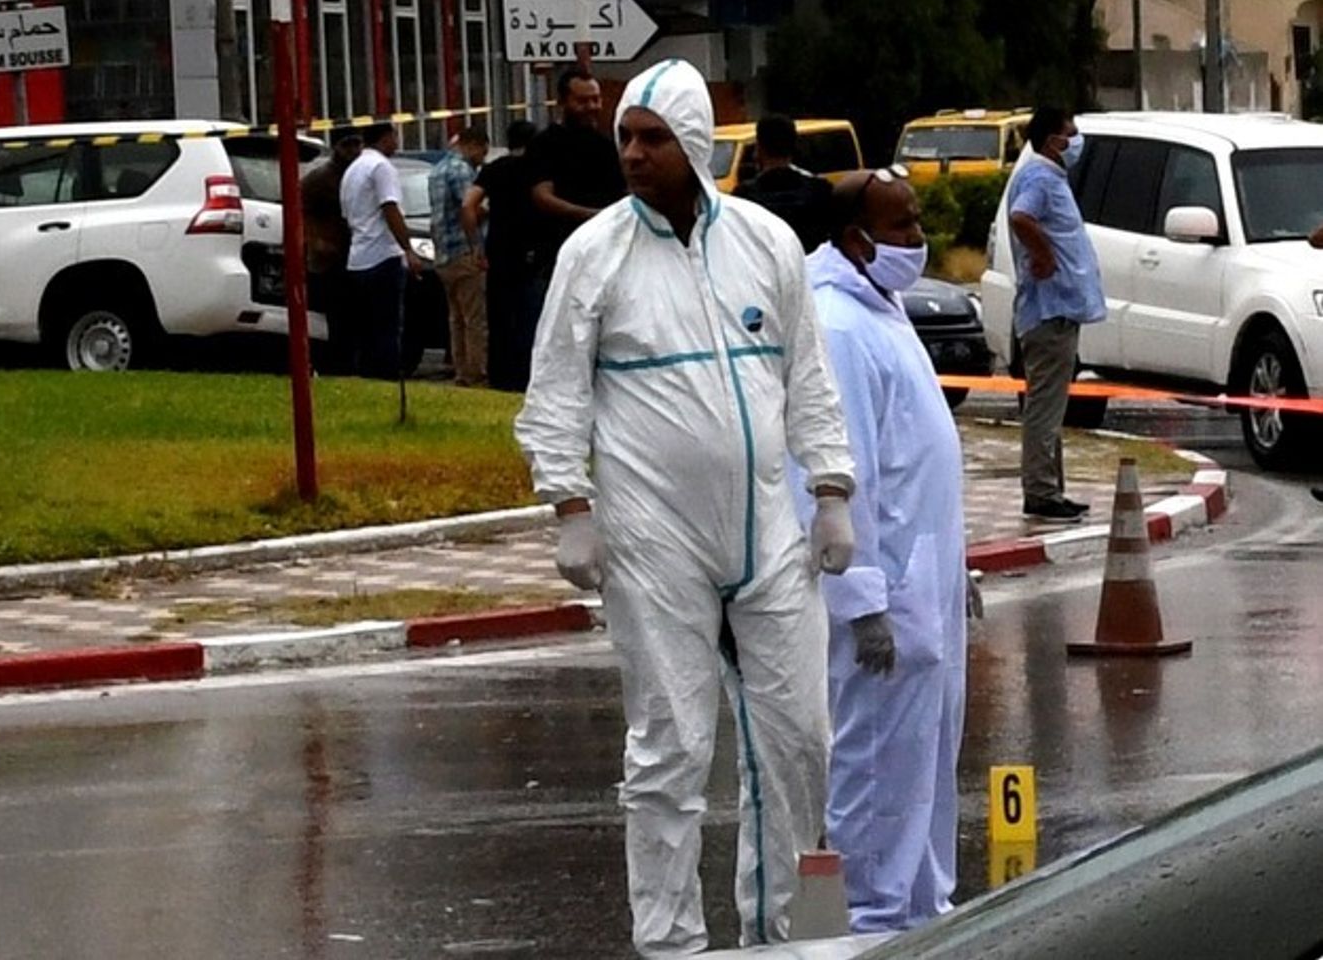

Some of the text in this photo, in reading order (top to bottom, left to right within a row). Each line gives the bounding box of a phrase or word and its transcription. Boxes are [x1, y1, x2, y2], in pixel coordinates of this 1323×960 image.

[8, 13, 60, 49] حمام
[8, 47, 64, 67] SOUSSE
[1003, 773, 1022, 824] 6
